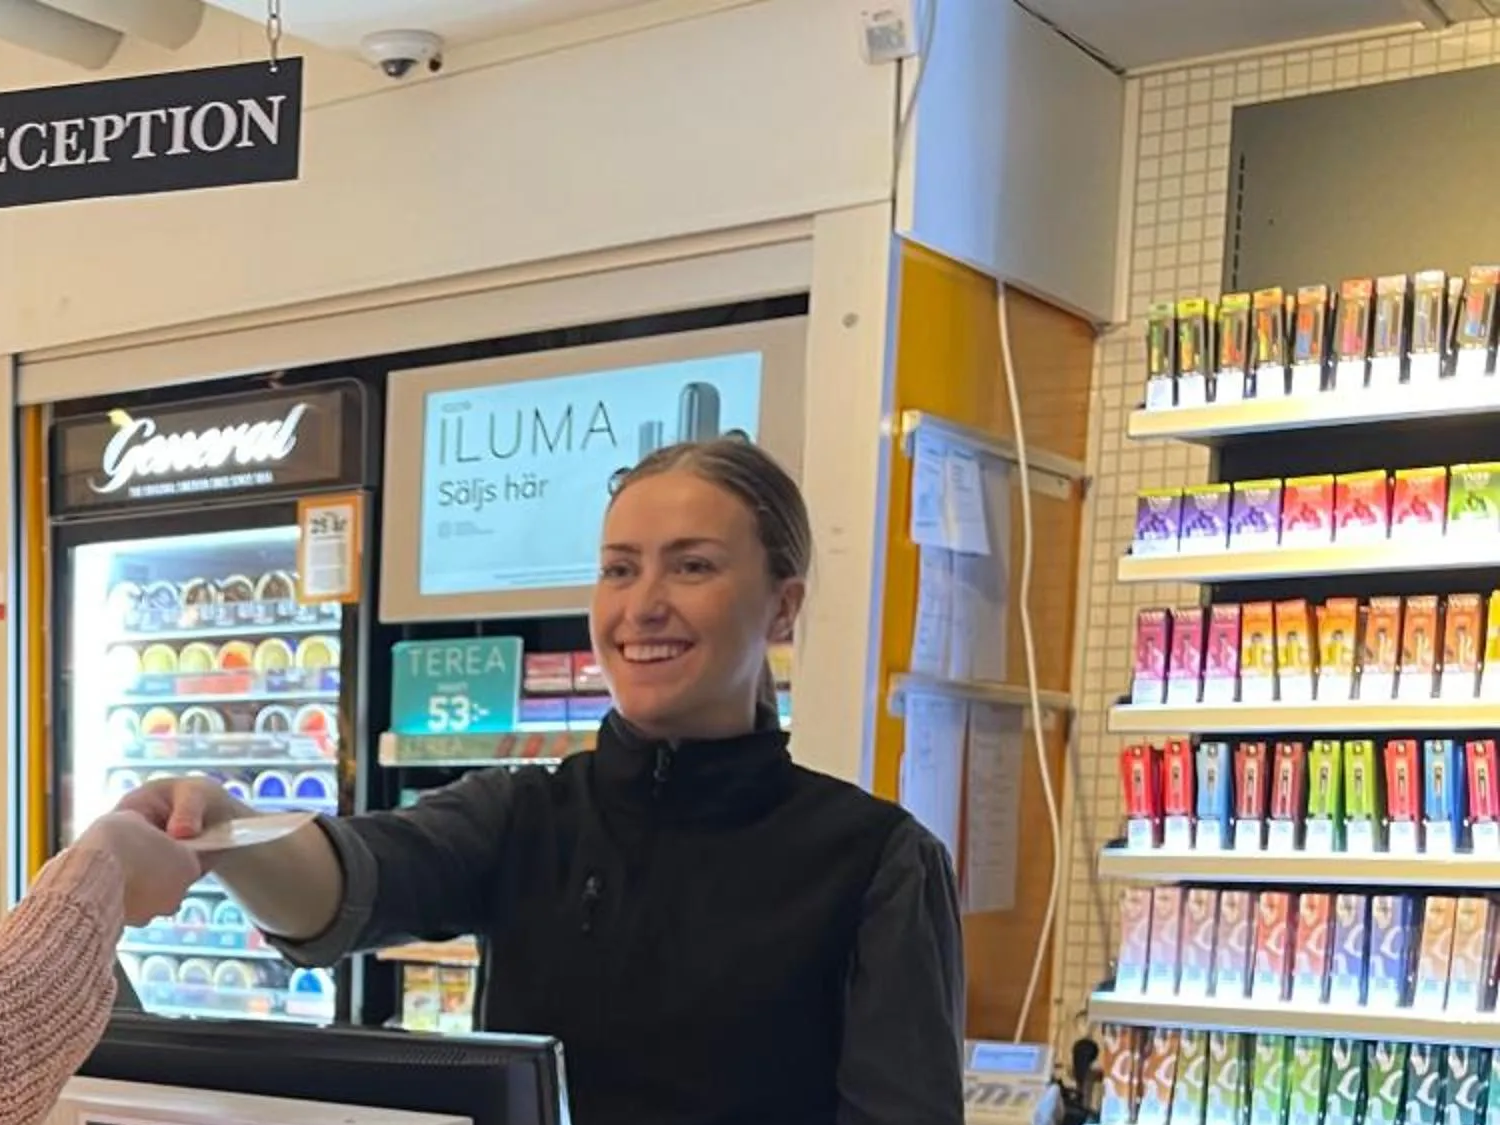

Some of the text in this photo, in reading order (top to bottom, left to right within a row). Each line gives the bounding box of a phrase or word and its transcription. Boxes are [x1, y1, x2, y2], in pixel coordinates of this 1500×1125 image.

[88, 403, 318, 493] General
[440, 400, 617, 465] ILUMA
[438, 473, 549, 512] Säljs här
[409, 646, 506, 678] TEREA
[427, 694, 489, 732] 53:-
